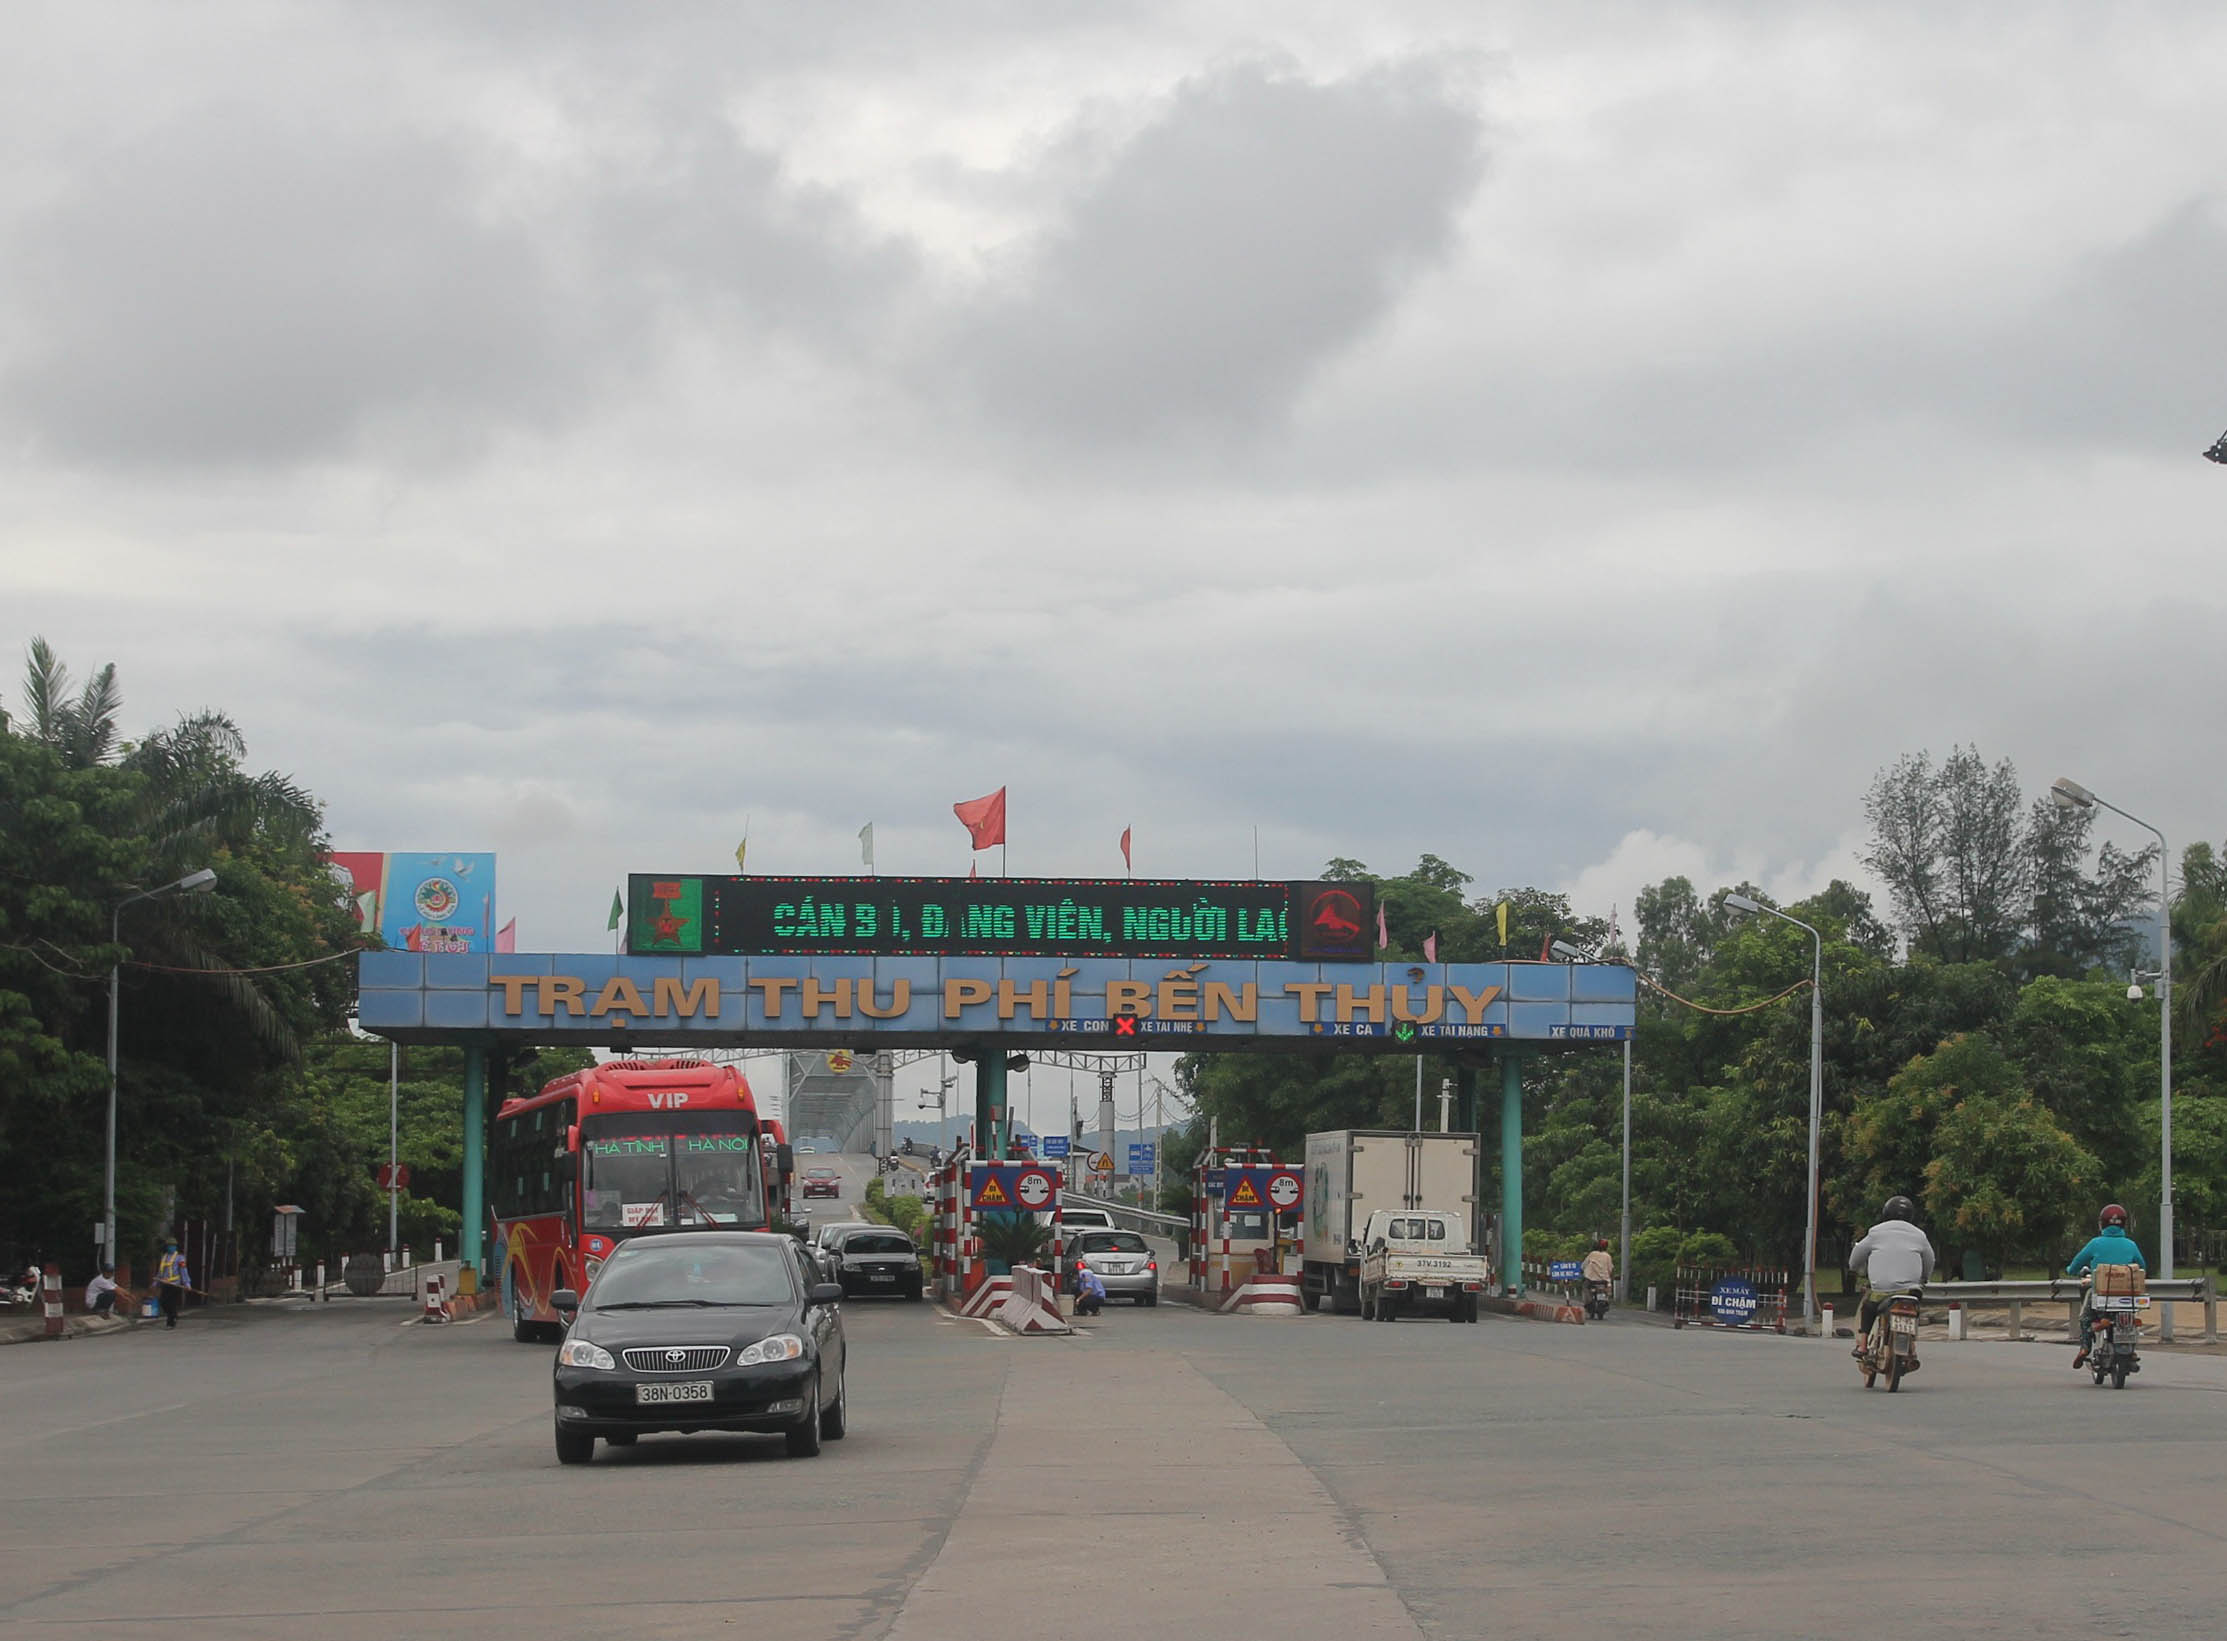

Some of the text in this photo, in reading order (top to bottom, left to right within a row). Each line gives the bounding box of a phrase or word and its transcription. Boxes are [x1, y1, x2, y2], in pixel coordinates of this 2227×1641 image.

[772, 895, 847, 937] CÁN
[1024, 898, 1112, 943] VIÊN,
[489, 963, 1503, 1028] TRẠM THU PHÍ BẾN THỦY
[1061, 1020, 1109, 1032] XE CON
[1140, 1021, 1153, 1032] XE
[1333, 1023, 1350, 1035] XE
[1421, 1025, 1436, 1037] XE
[1551, 1026, 1566, 1038] XE
[648, 1093, 689, 1109] VIP
[1027, 1176, 1042, 1185] 8m
[1279, 1178, 1294, 1187] 8m
[1725, 1296, 1756, 1309] CHẬM
[642, 1384, 708, 1402] 38N-0358
